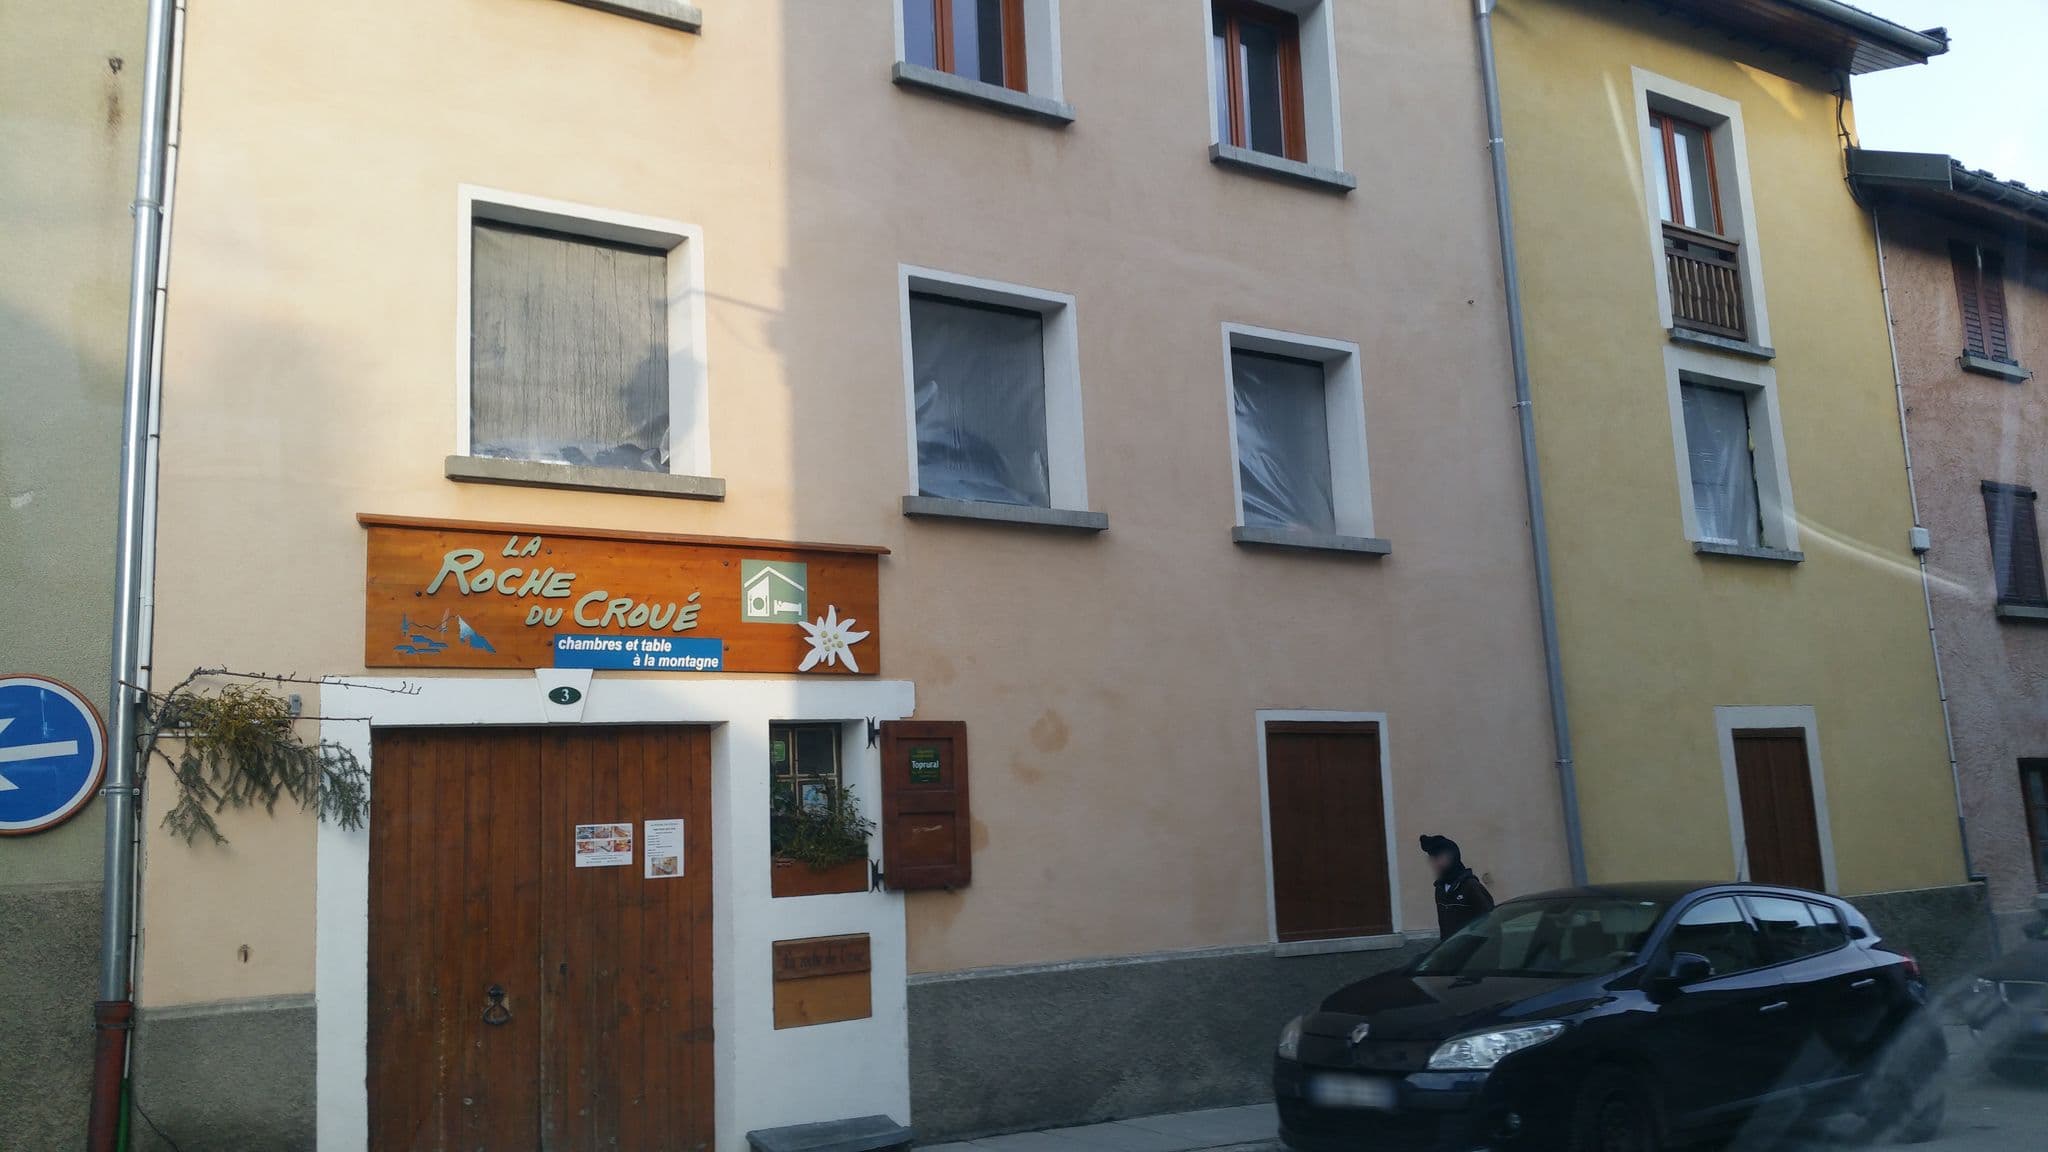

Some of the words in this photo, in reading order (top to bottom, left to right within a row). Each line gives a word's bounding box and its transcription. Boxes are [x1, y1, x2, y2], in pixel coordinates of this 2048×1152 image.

[502, 535, 542, 557] LA
[426, 548, 576, 598] ROCHE
[525, 604, 563, 627] DU
[573, 590, 701, 632] CROUÉ
[558, 636, 623, 651] chambres
[625, 638, 639, 651] et
[641, 639, 672, 652] table
[633, 653, 641, 667] à
[644, 654, 655, 667] la
[658, 656, 719, 671] montagne
[561, 688, 570, 702] 3
